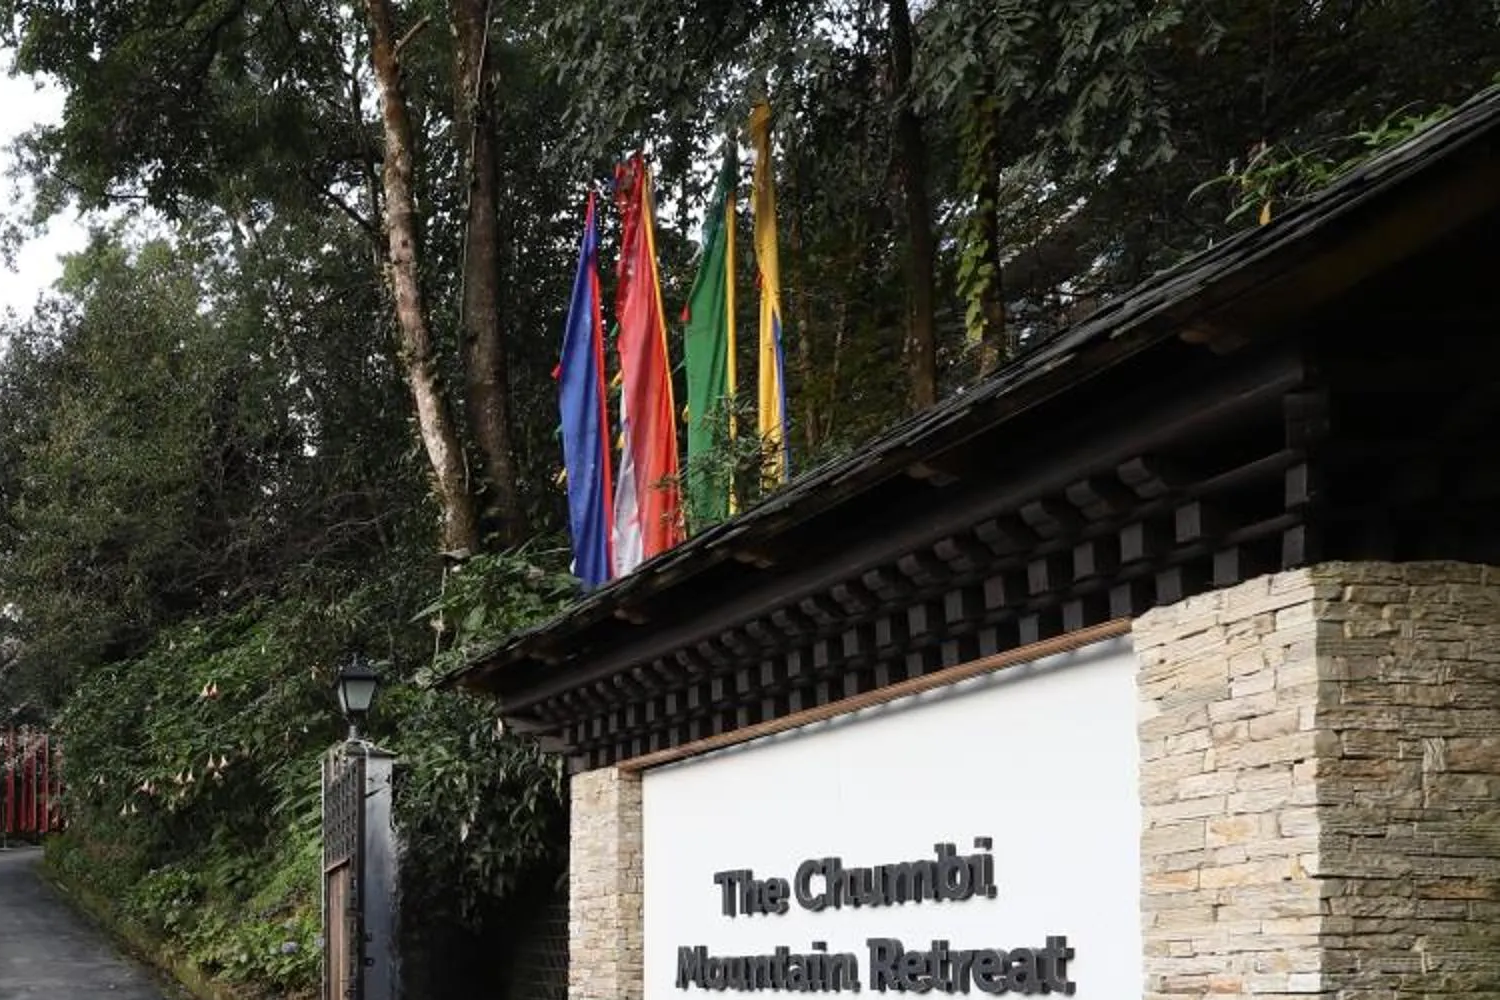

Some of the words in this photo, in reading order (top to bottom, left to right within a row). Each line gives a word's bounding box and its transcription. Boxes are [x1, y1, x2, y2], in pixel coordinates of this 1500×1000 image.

[714, 869, 791, 917] The
[794, 837, 998, 912] Chumbi
[675, 941, 861, 994] Mountain
[866, 936, 1076, 997] Retreat
